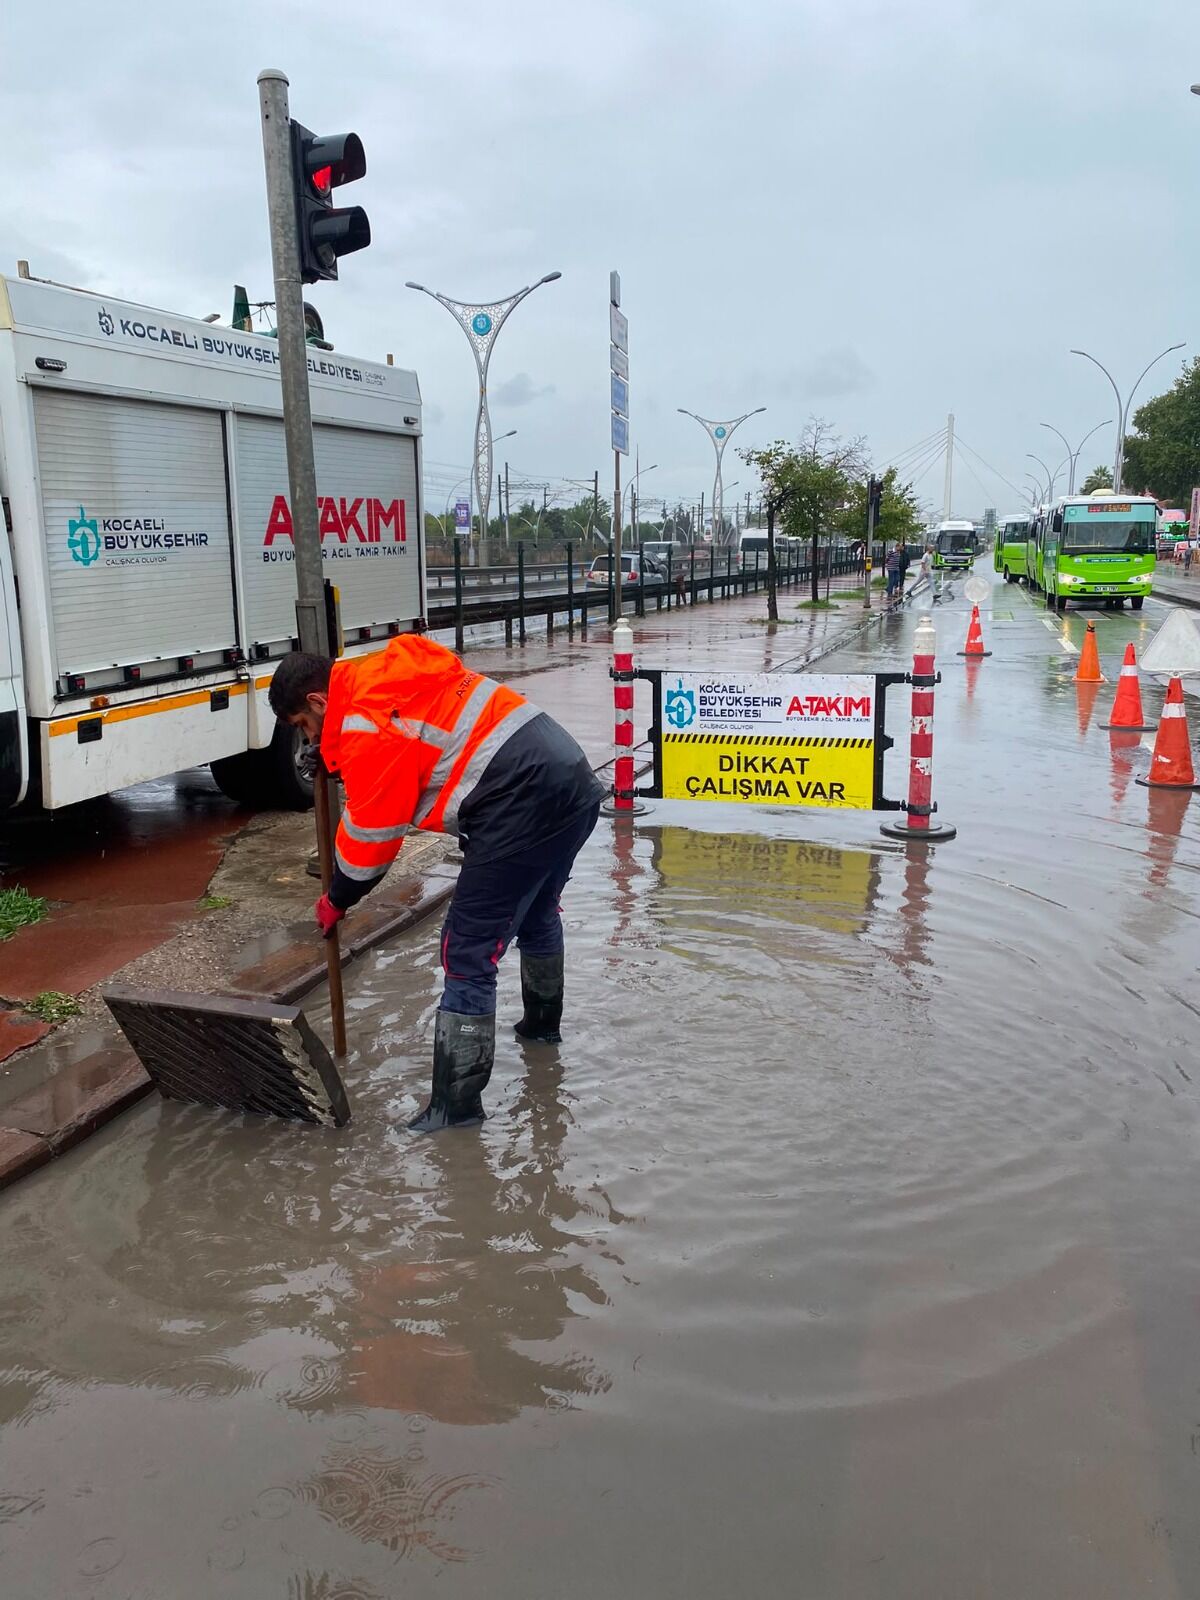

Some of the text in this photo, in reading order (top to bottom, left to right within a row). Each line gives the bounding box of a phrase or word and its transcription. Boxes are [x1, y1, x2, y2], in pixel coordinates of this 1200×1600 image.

[120, 319, 362, 382] KOCAELİ BÜYÜKŞEH ELEDİYESİ
[103, 519, 164, 531] KOCAELİ
[104, 533, 209, 549] BÜYÜKŞEHİR
[699, 685, 746, 694] KOCAELİ
[699, 696, 782, 708] BÜYÜKŞEHİR
[786, 696, 871, 717] A-TAKIMI
[699, 708, 762, 718] BELEDİYESİ
[719, 751, 810, 775] DİKKAT
[685, 776, 845, 800] ÇALIŞMA VAR
